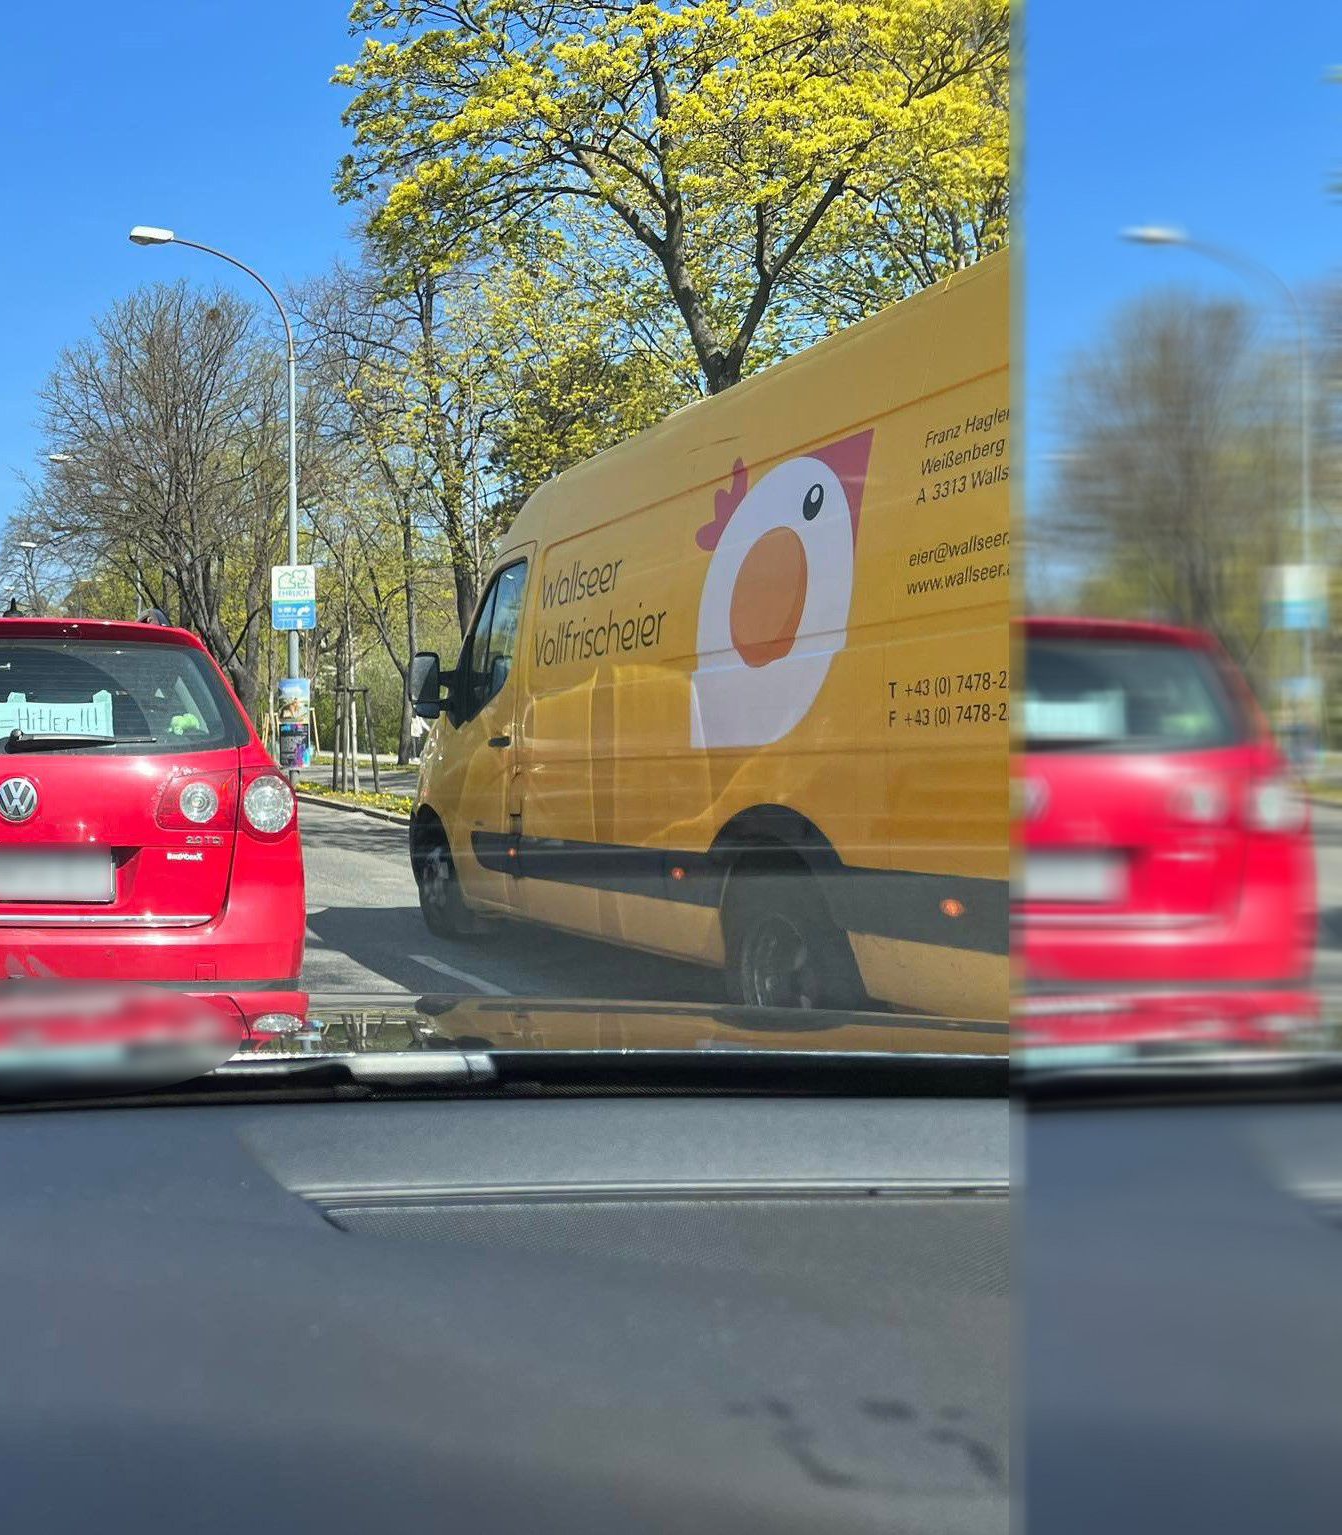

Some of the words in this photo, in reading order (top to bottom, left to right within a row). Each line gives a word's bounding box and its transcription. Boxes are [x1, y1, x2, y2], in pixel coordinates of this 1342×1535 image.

[925, 424, 962, 448] Franz
[921, 438, 1006, 476] Weißenberg
[916, 487, 926, 505] A
[933, 475, 968, 501] 3313
[542, 559, 623, 610] Wallseer
[535, 601, 667, 668] Vollfrischeier
[888, 682, 897, 699] T
[905, 678, 930, 697] +43
[934, 676, 951, 697] (0)
[888, 710, 896, 727] F
[904, 707, 930, 728] +43
[934, 706, 951, 727] (0)
